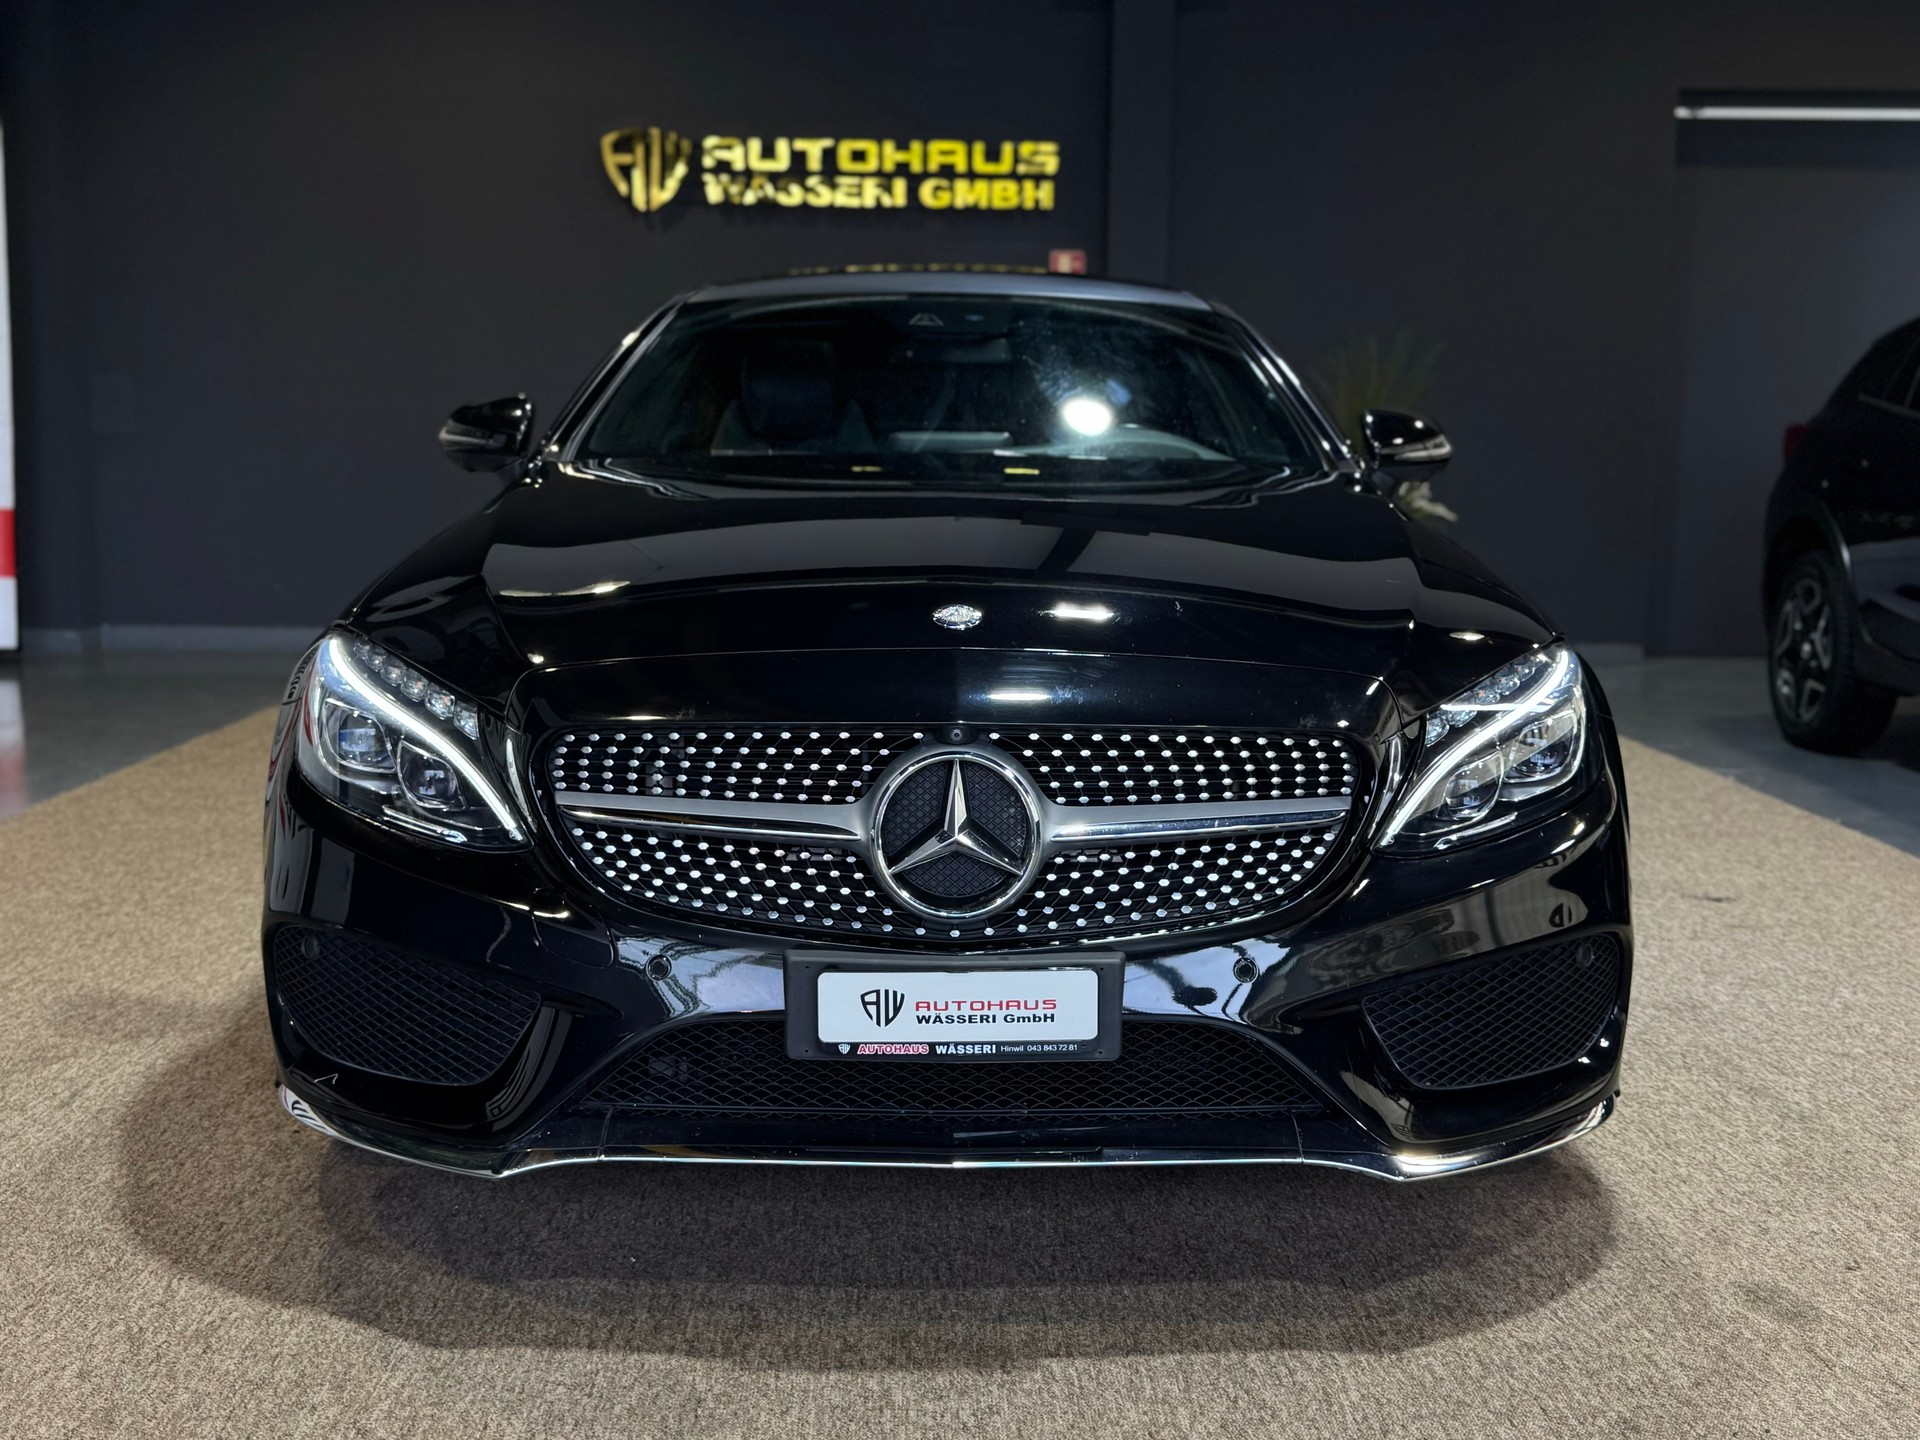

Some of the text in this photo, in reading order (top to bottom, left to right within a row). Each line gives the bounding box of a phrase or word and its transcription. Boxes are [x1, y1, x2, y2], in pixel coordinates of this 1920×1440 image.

[701, 136, 1060, 176] AUTOHAUS
[919, 177, 1055, 211] GMBH
[915, 999, 1057, 1012] AUTOHAUS
[916, 1012, 1055, 1025] WÄSSERI GmbH
[857, 1043, 930, 1055] AUTOHAUS
[935, 1043, 997, 1055] WÄSSERI
[1000, 1045, 1024, 1053] Hinwil
[1026, 1044, 1042, 1052] 043
[1043, 1044, 1058, 1052] 843
